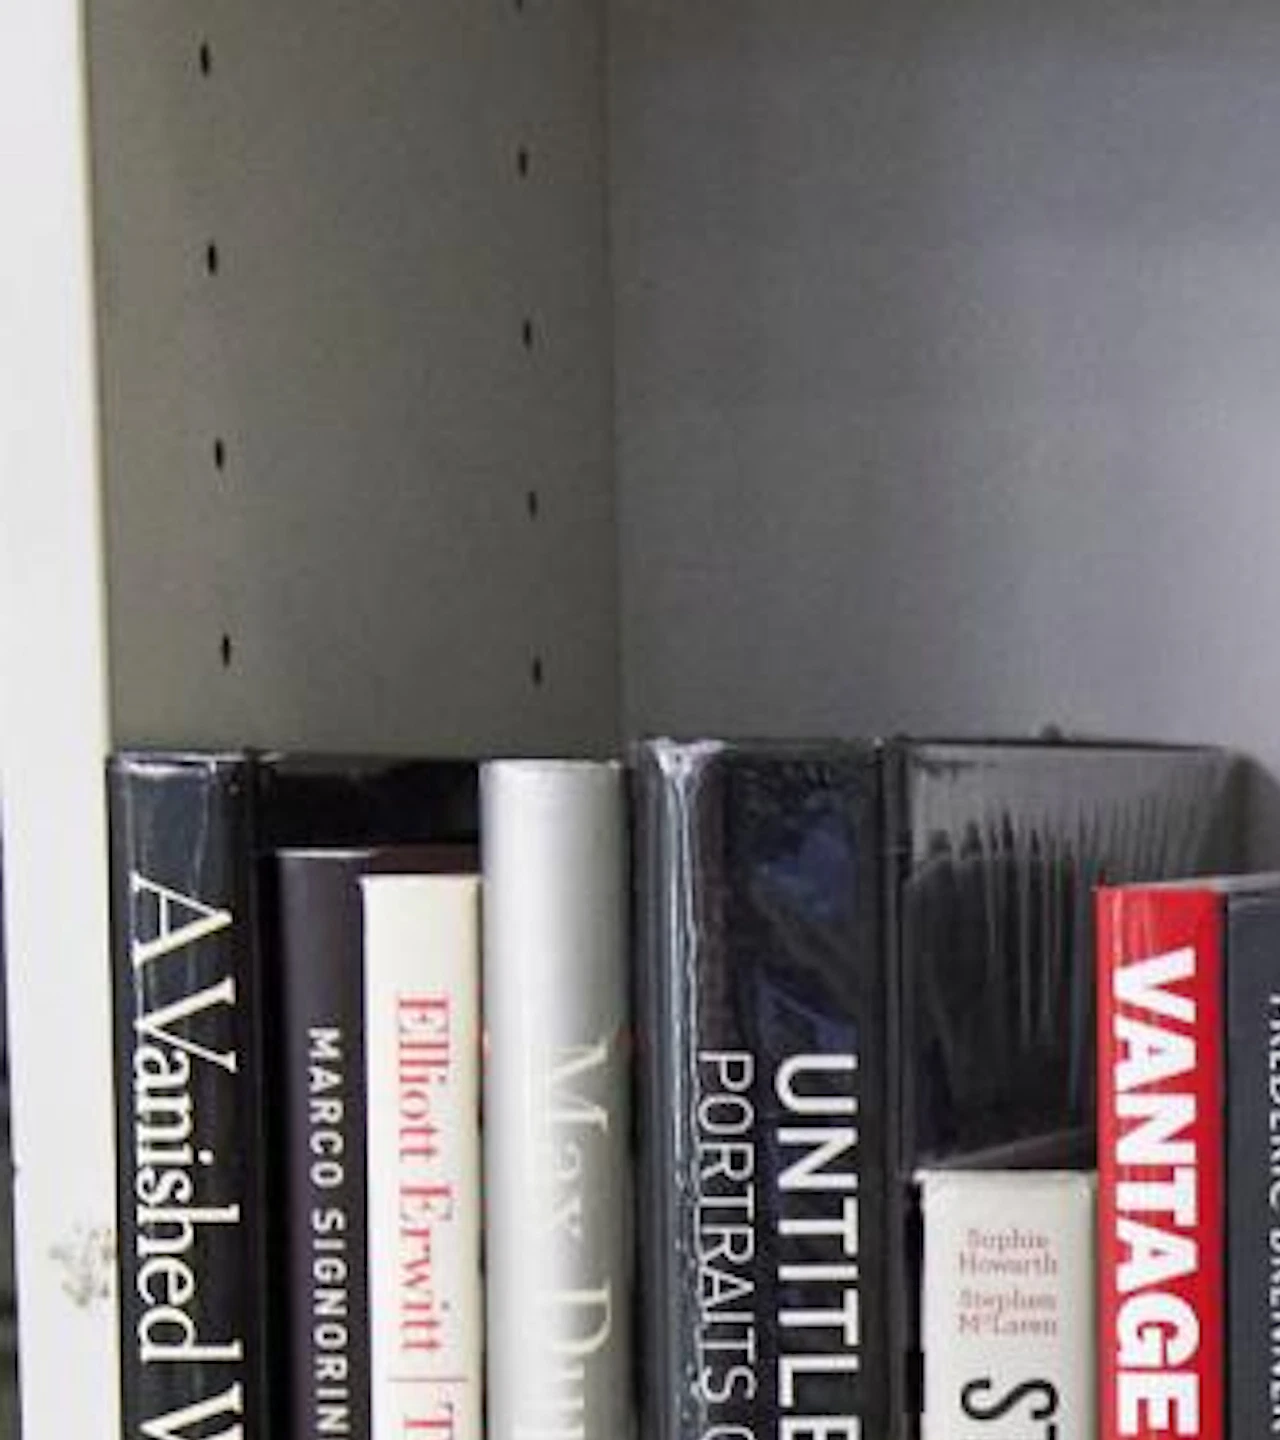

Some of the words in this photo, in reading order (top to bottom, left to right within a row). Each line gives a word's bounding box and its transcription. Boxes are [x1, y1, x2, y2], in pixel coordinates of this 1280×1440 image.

[128, 872, 234, 966] A
[307, 1026, 343, 1190] MARCO
[398, 995, 449, 1163] Elliott
[545, 1040, 612, 1241] Max
[132, 975, 241, 1363] Vanished
[699, 1050, 756, 1403] PORTRAITS
[967, 1228, 1048, 1251] Sophie
[1113, 947, 1200, 1436] VANTAGE
[398, 1184, 453, 1352] Erwitt
[958, 1251, 1059, 1276] Howarth
[961, 1287, 1058, 1312] Stephen
